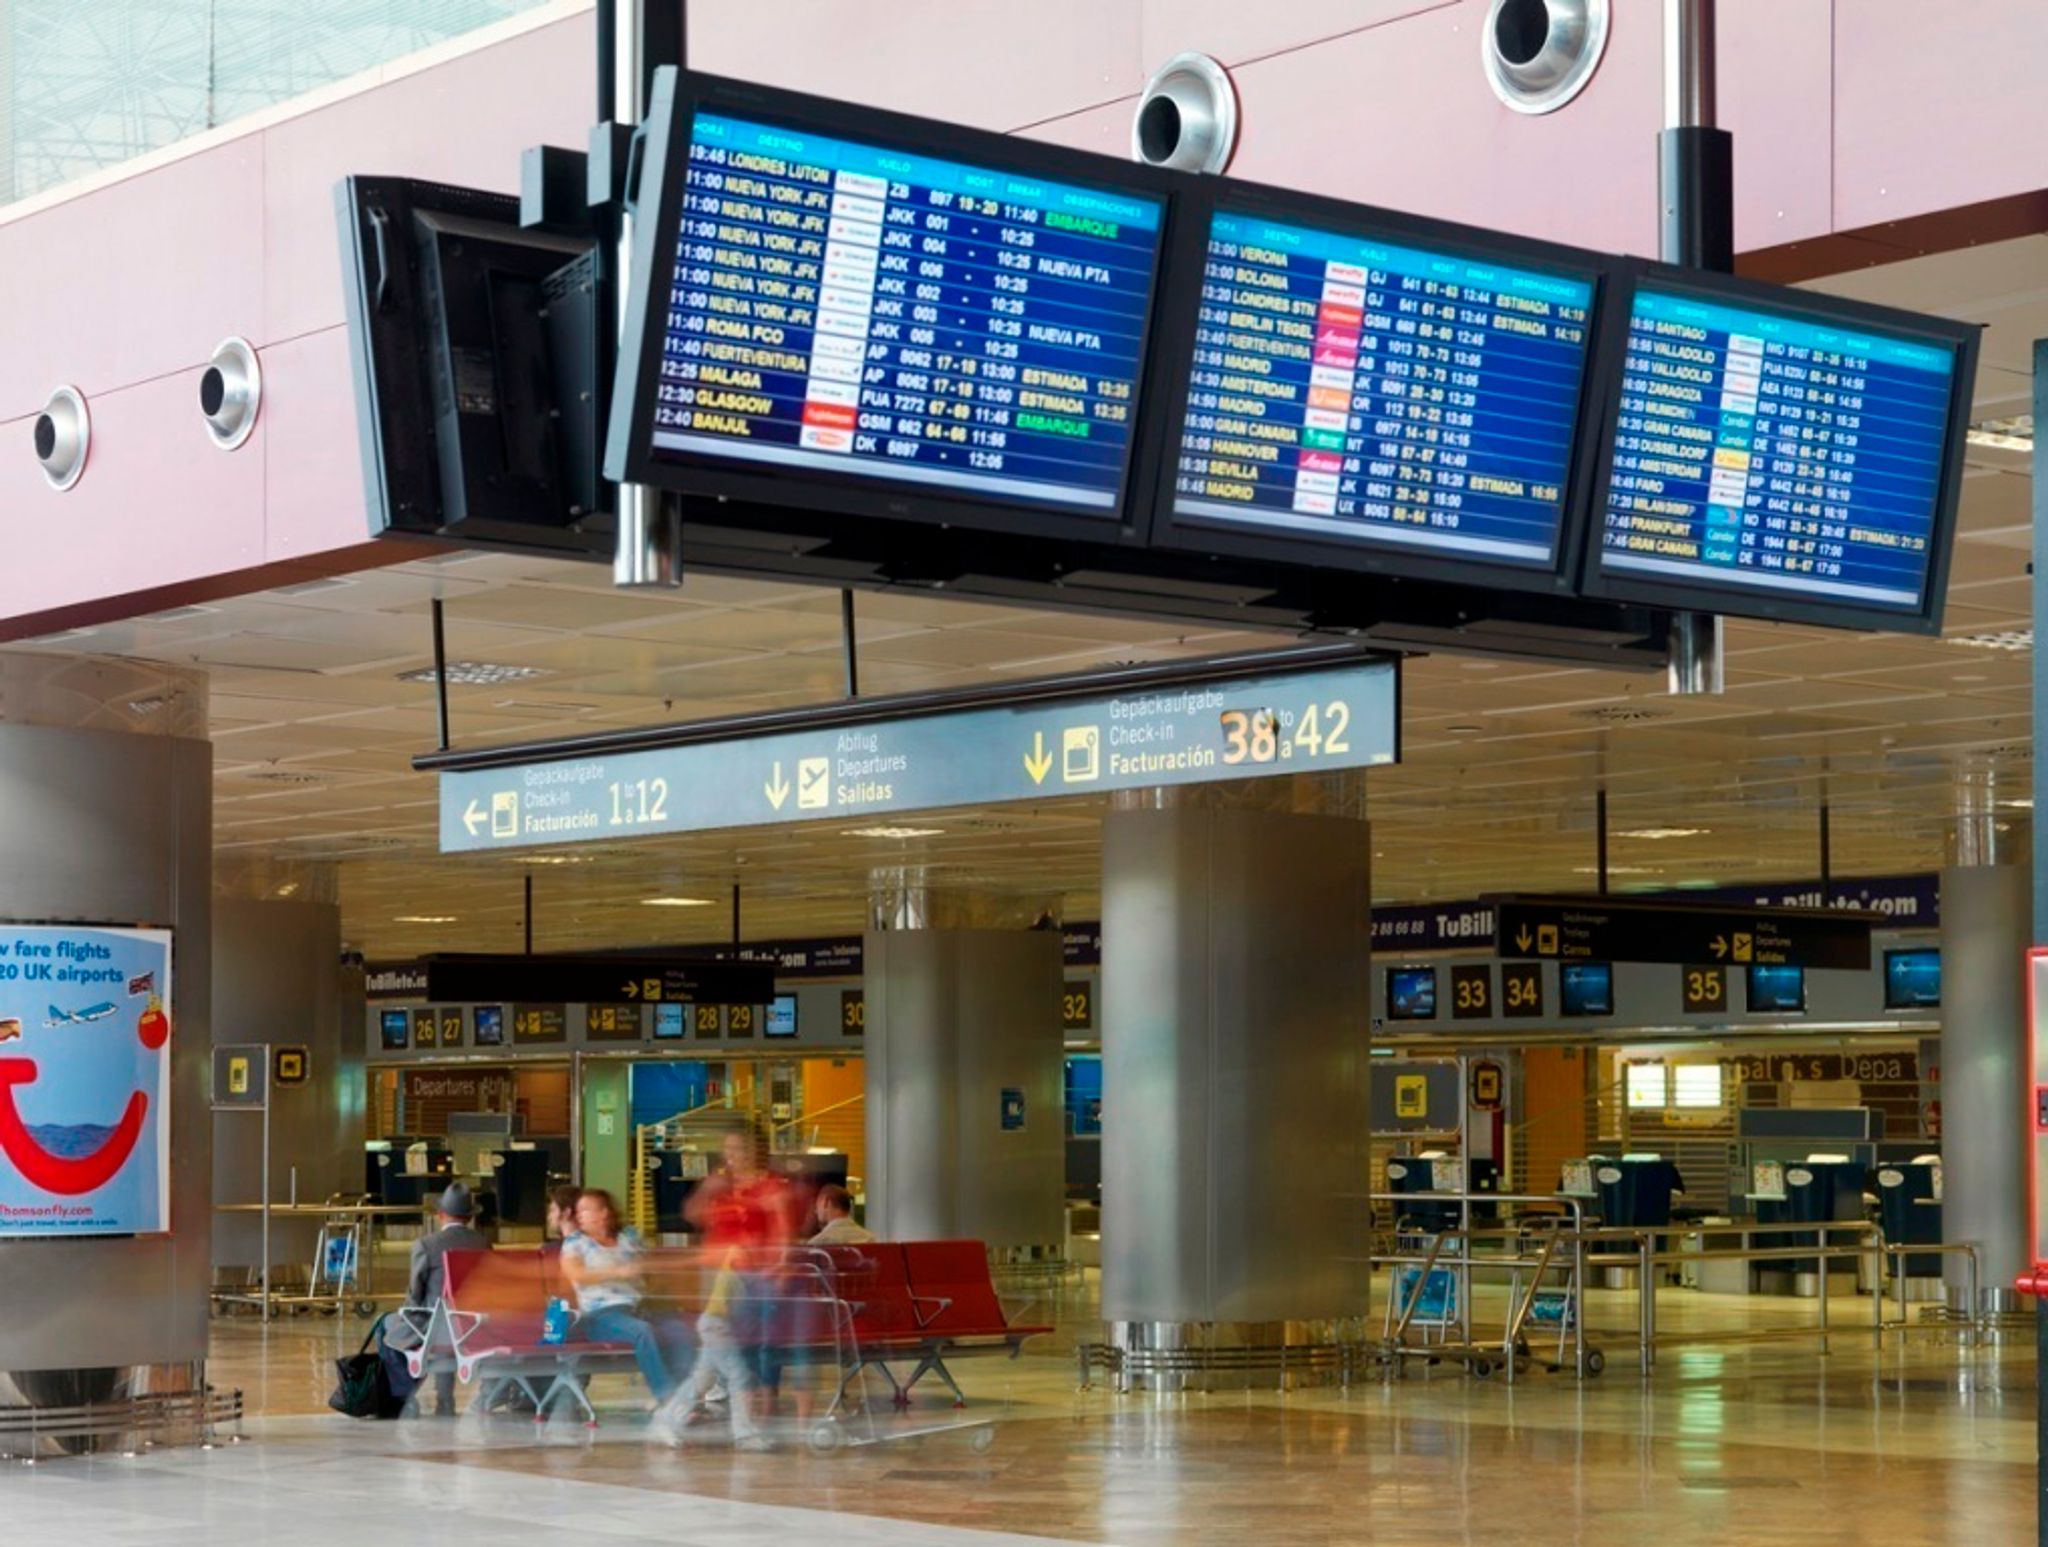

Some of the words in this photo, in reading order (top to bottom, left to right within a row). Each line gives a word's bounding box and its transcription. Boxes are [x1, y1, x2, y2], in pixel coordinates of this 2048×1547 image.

[724, 176, 767, 198] NUEVA
[769, 184, 803, 204] YORK
[803, 191, 829, 209] JFK
[727, 151, 787, 176] LONDRES
[787, 162, 830, 184] LUTON
[1045, 210, 1118, 238] EMBARQUE
[717, 225, 761, 246] NUEVA
[763, 233, 797, 252] YORK
[797, 239, 822, 257] JFK
[721, 200, 764, 222] NUEVA
[766, 209, 800, 228] YORK
[800, 215, 825, 233] JFK
[1037, 258, 1082, 279] NUEVA
[1084, 266, 1110, 284] PTA
[714, 248, 757, 270] NUEVA
[758, 256, 793, 275] YORK
[793, 262, 818, 280] JFK
[708, 295, 751, 316] NUEVA
[752, 302, 787, 321] YORK
[787, 307, 812, 325] JFK
[711, 271, 755, 293] NUEVA
[756, 279, 791, 298] YORK
[790, 285, 816, 302] JFK
[1028, 324, 1073, 345] NUEVA
[1075, 332, 1101, 350] PTA
[705, 317, 750, 339] ROMA
[752, 324, 785, 345] FCO
[1022, 368, 1088, 392] ESTIMADA
[702, 341, 806, 372] FUERTEVENTURA
[1018, 390, 1085, 414] ESTIMADA
[695, 388, 773, 414] GLASGOW
[699, 365, 762, 389] MALAGA
[1016, 412, 1089, 437] EMBARQUE
[692, 412, 750, 435] BANJUL
[837, 734, 878, 753] Abflug
[1110, 723, 1174, 747] Check-in
[1221, 709, 1276, 765] 38
[1280, 708, 1294, 727] to
[1295, 700, 1350, 757] 42
[1110, 744, 1216, 775] Facturación
[1281, 740, 1291, 759] a
[837, 753, 908, 779] Departures
[609, 781, 623, 825] 1
[636, 776, 669, 823] 12
[837, 781, 893, 805] Salidas
[525, 808, 598, 833] Facturación
[15, 940, 52, 957] fare
[57, 940, 111, 962] flights
[24, 962, 52, 980] UK
[57, 964, 124, 986] airports
[1688, 972, 1721, 1001] 35
[1457, 980, 1486, 1008] 33
[1507, 977, 1538, 1007] 34
[698, 1007, 718, 1030] 28
[730, 1006, 751, 1029] 29
[844, 1002, 863, 1026] 30
[1063, 994, 1087, 1020] 32
[416, 1020, 434, 1041] 26
[443, 1018, 461, 1040] 27
